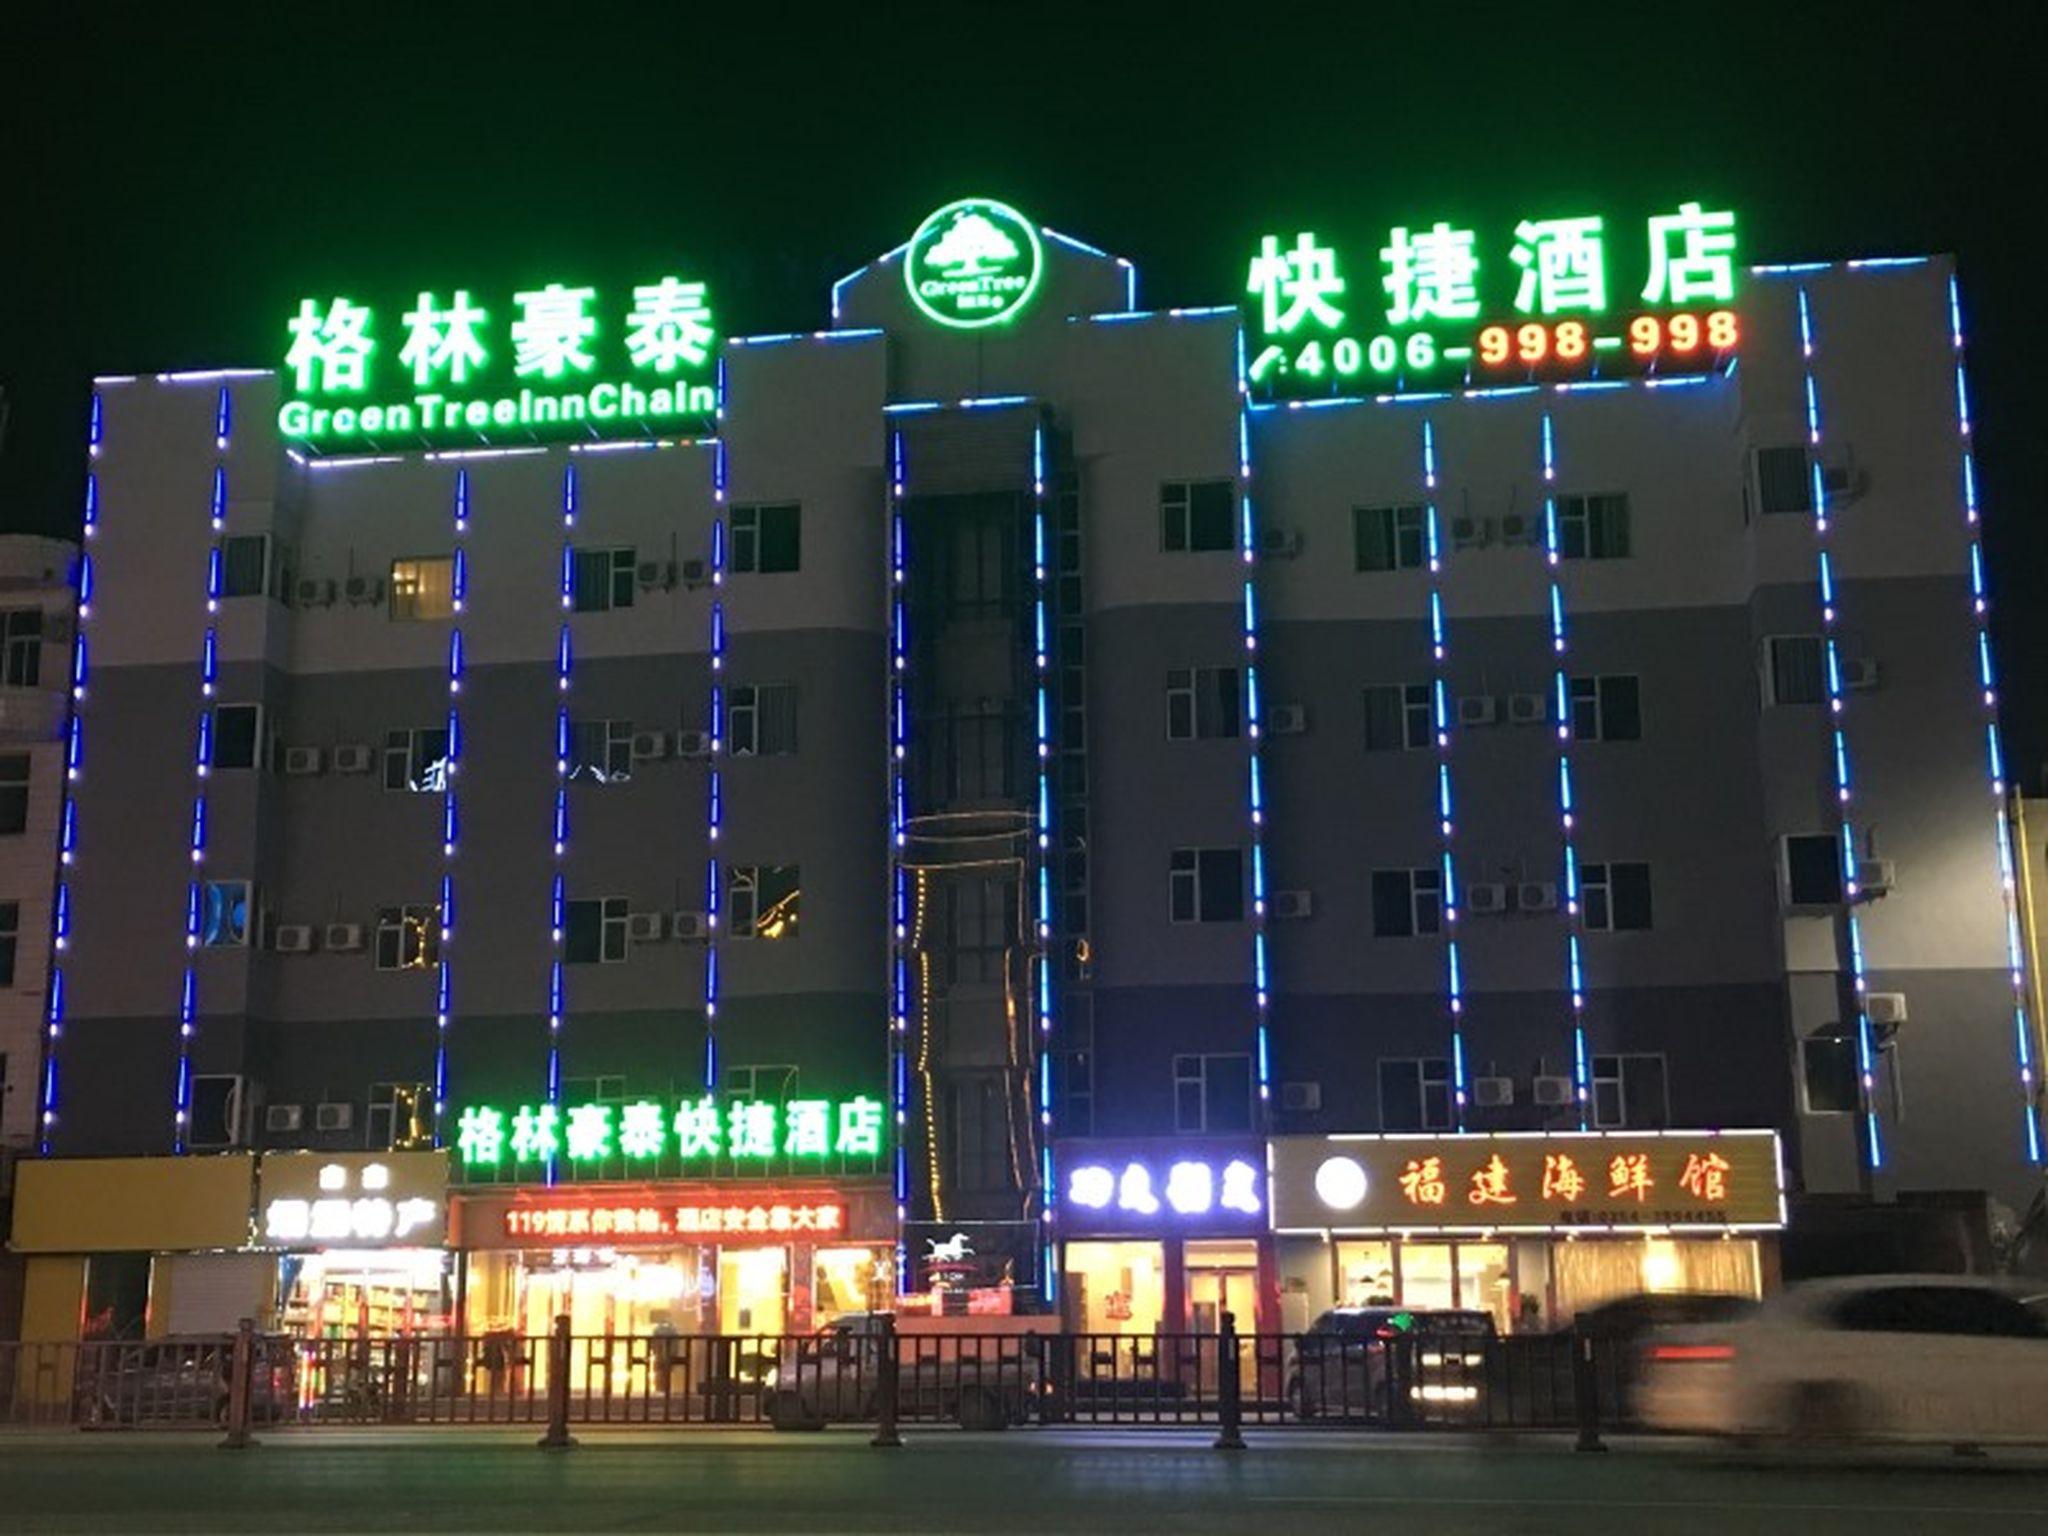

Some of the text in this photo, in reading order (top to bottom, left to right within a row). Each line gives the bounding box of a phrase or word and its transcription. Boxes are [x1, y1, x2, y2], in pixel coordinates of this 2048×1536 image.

[1246, 202, 1736, 334] 快捷酒店
[285, 277, 714, 391] 格林豪泰
[458, 1096, 882, 1164] 格林豪泰快捷酒店
[1399, 1153, 1729, 1204] 福建海鲜馆
